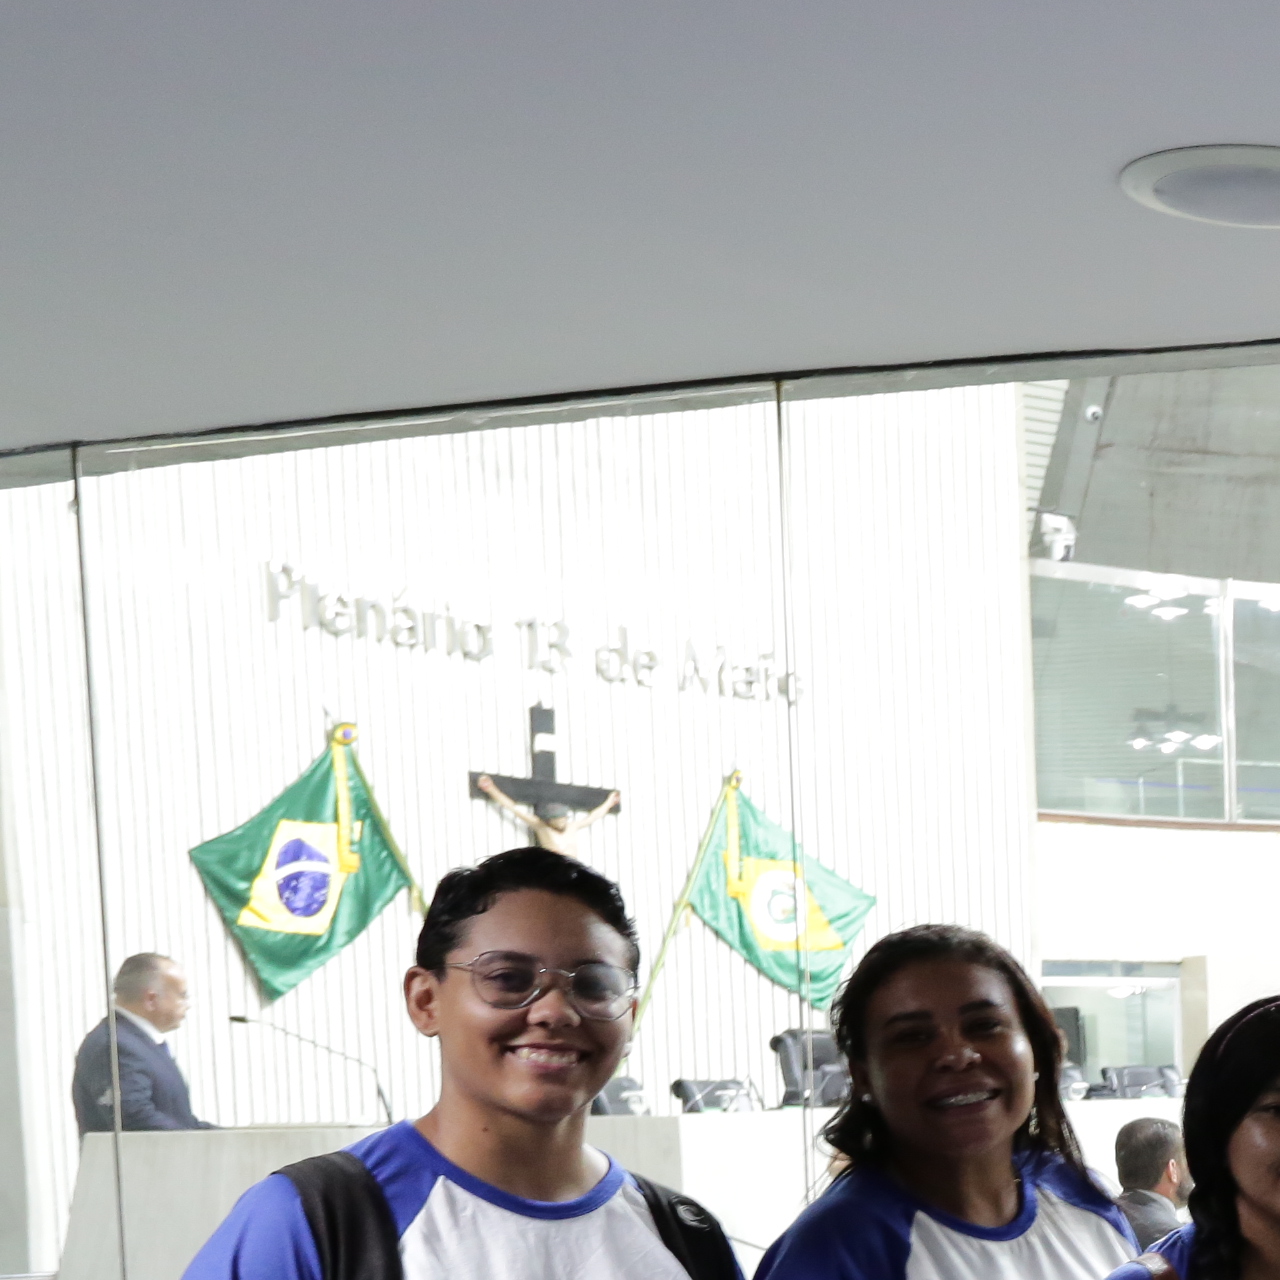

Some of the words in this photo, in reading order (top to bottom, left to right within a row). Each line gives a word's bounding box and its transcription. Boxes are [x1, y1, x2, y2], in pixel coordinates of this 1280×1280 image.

[264, 560, 494, 664] Plenário
[516, 616, 573, 674] 13
[594, 625, 658, 690] de
